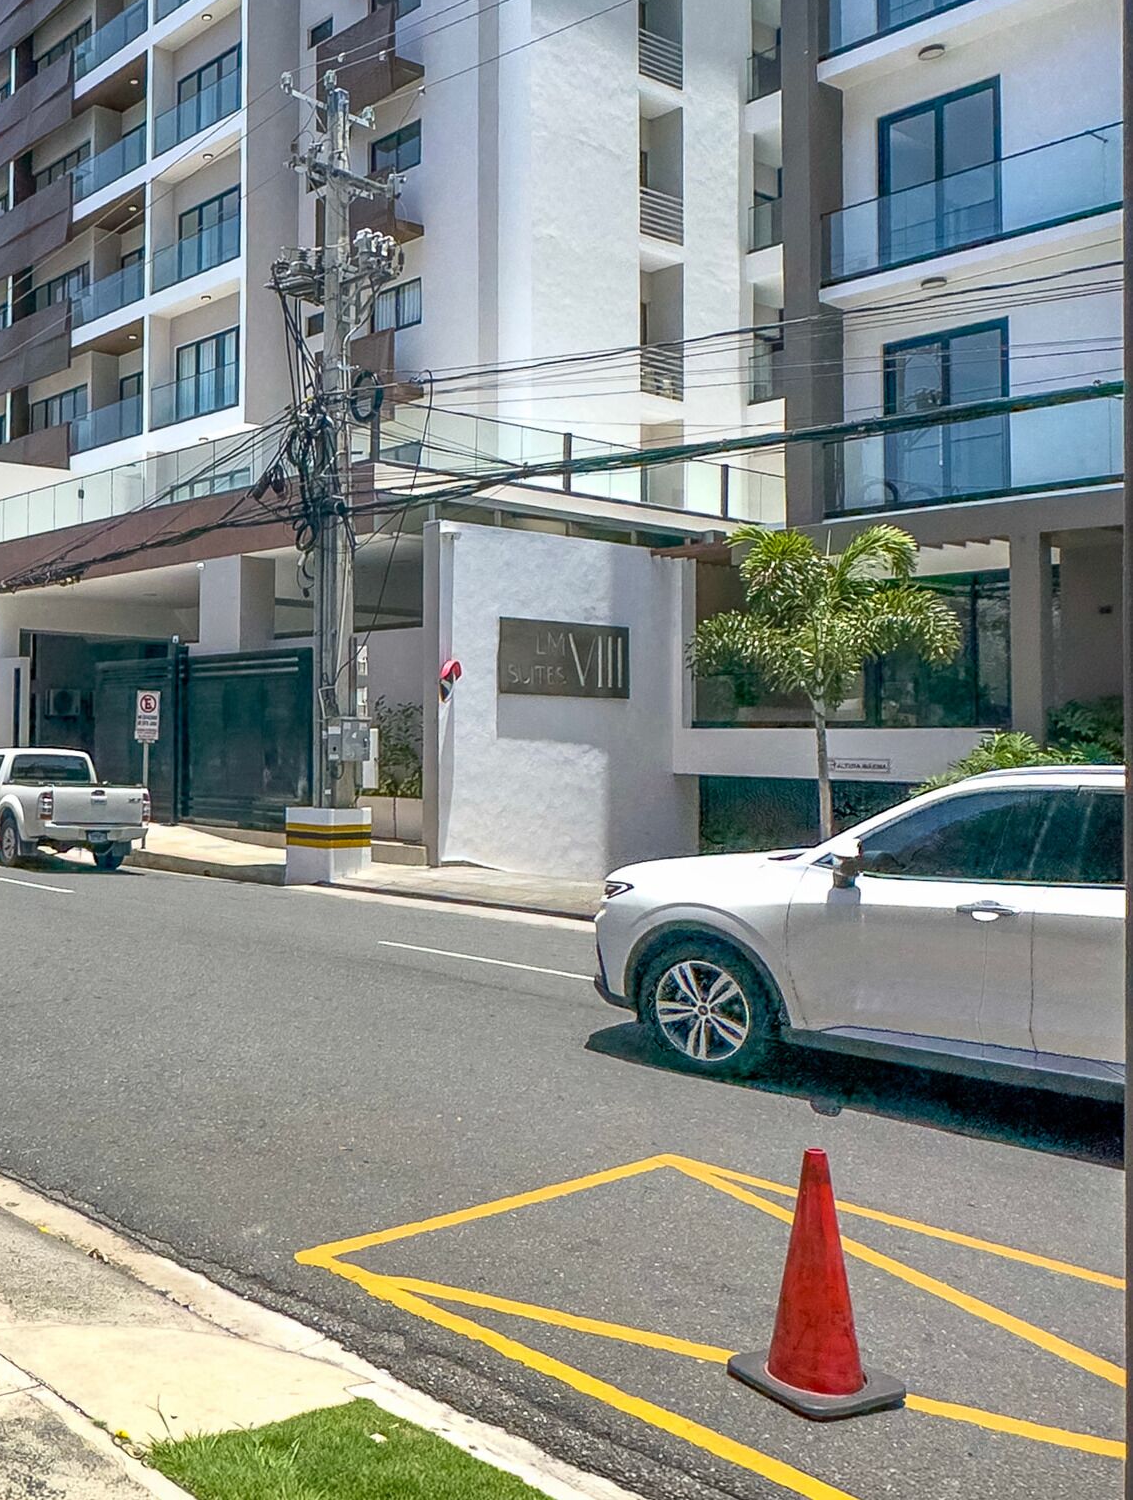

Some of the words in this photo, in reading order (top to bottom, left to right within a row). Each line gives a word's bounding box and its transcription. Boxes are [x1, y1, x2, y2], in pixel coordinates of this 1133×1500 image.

[536, 631, 565, 657] LM
[568, 632, 622, 689] VIII
[508, 664, 567, 685] SUITES
